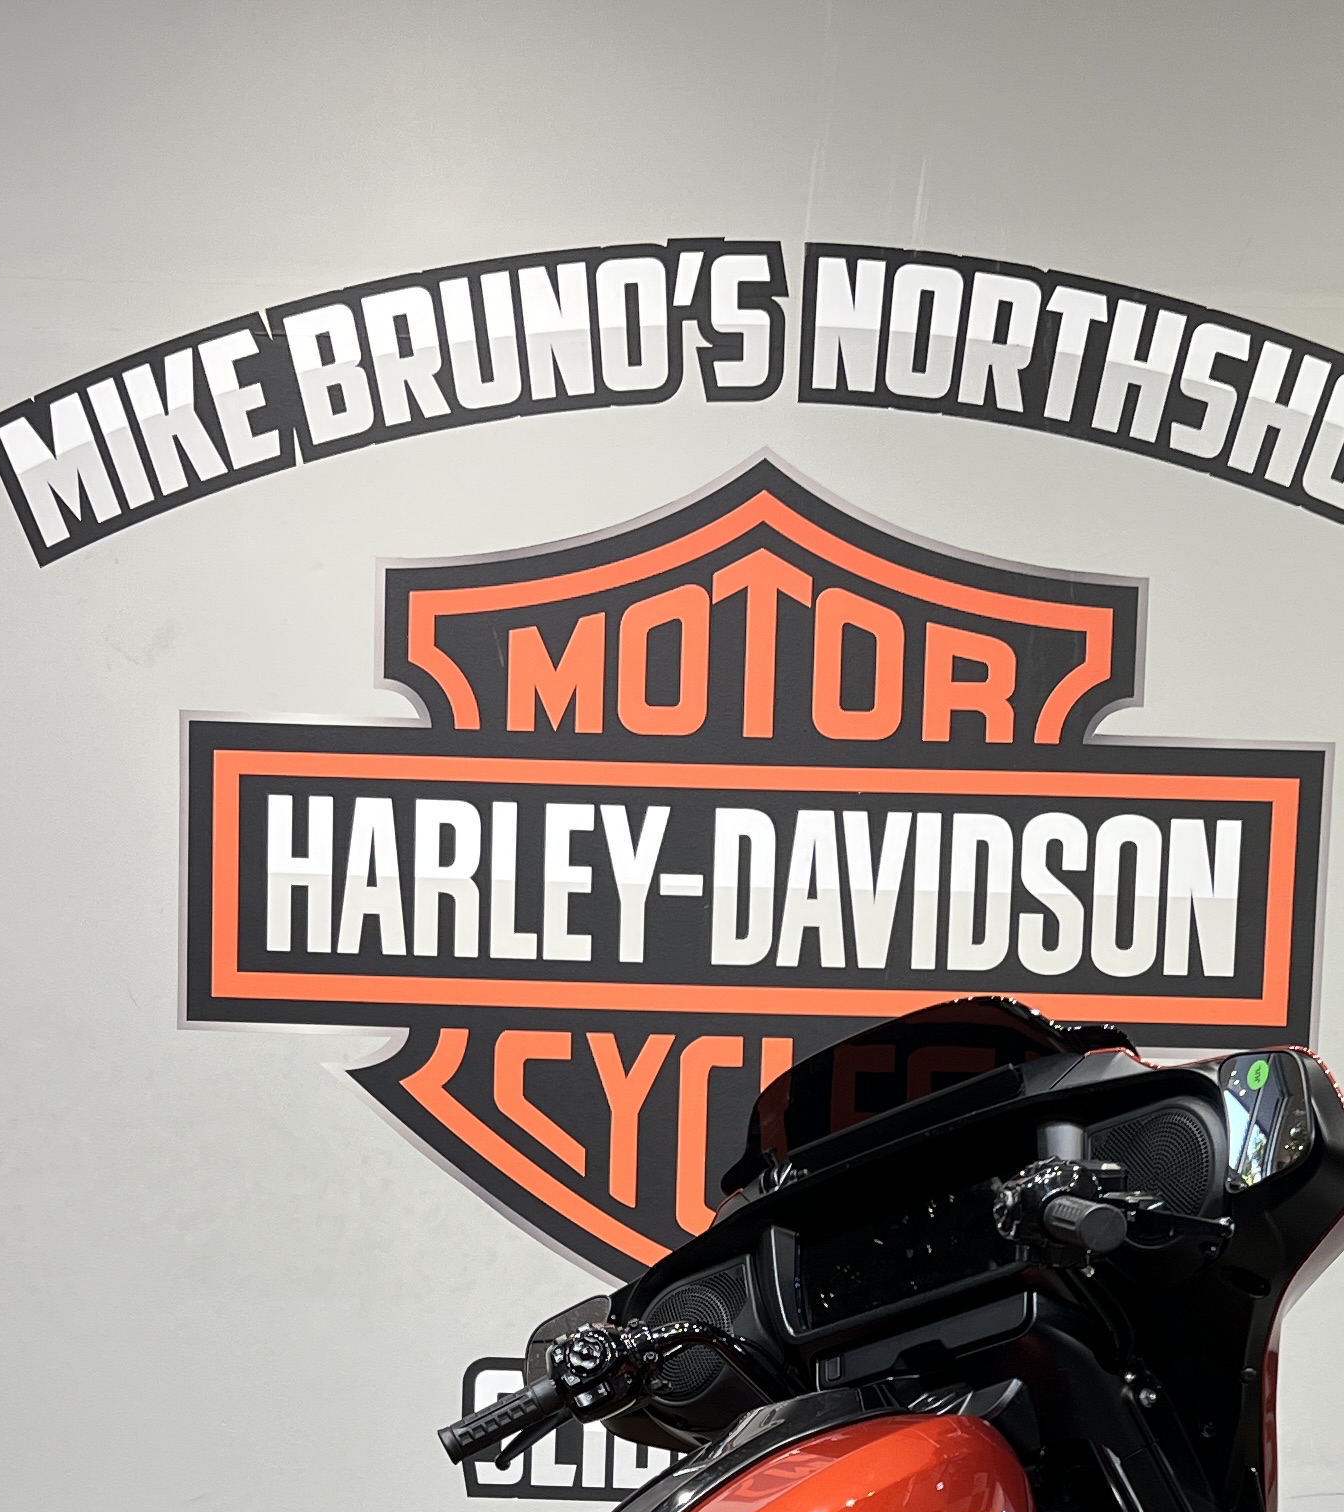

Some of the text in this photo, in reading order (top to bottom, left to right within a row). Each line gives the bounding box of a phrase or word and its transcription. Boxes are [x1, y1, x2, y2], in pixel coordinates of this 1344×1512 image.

[282, 250, 771, 447] BRUNO'S
[507, 546, 1016, 744] MOTOR
[265, 793, 1243, 979] HARLEY-DAVIDSON
